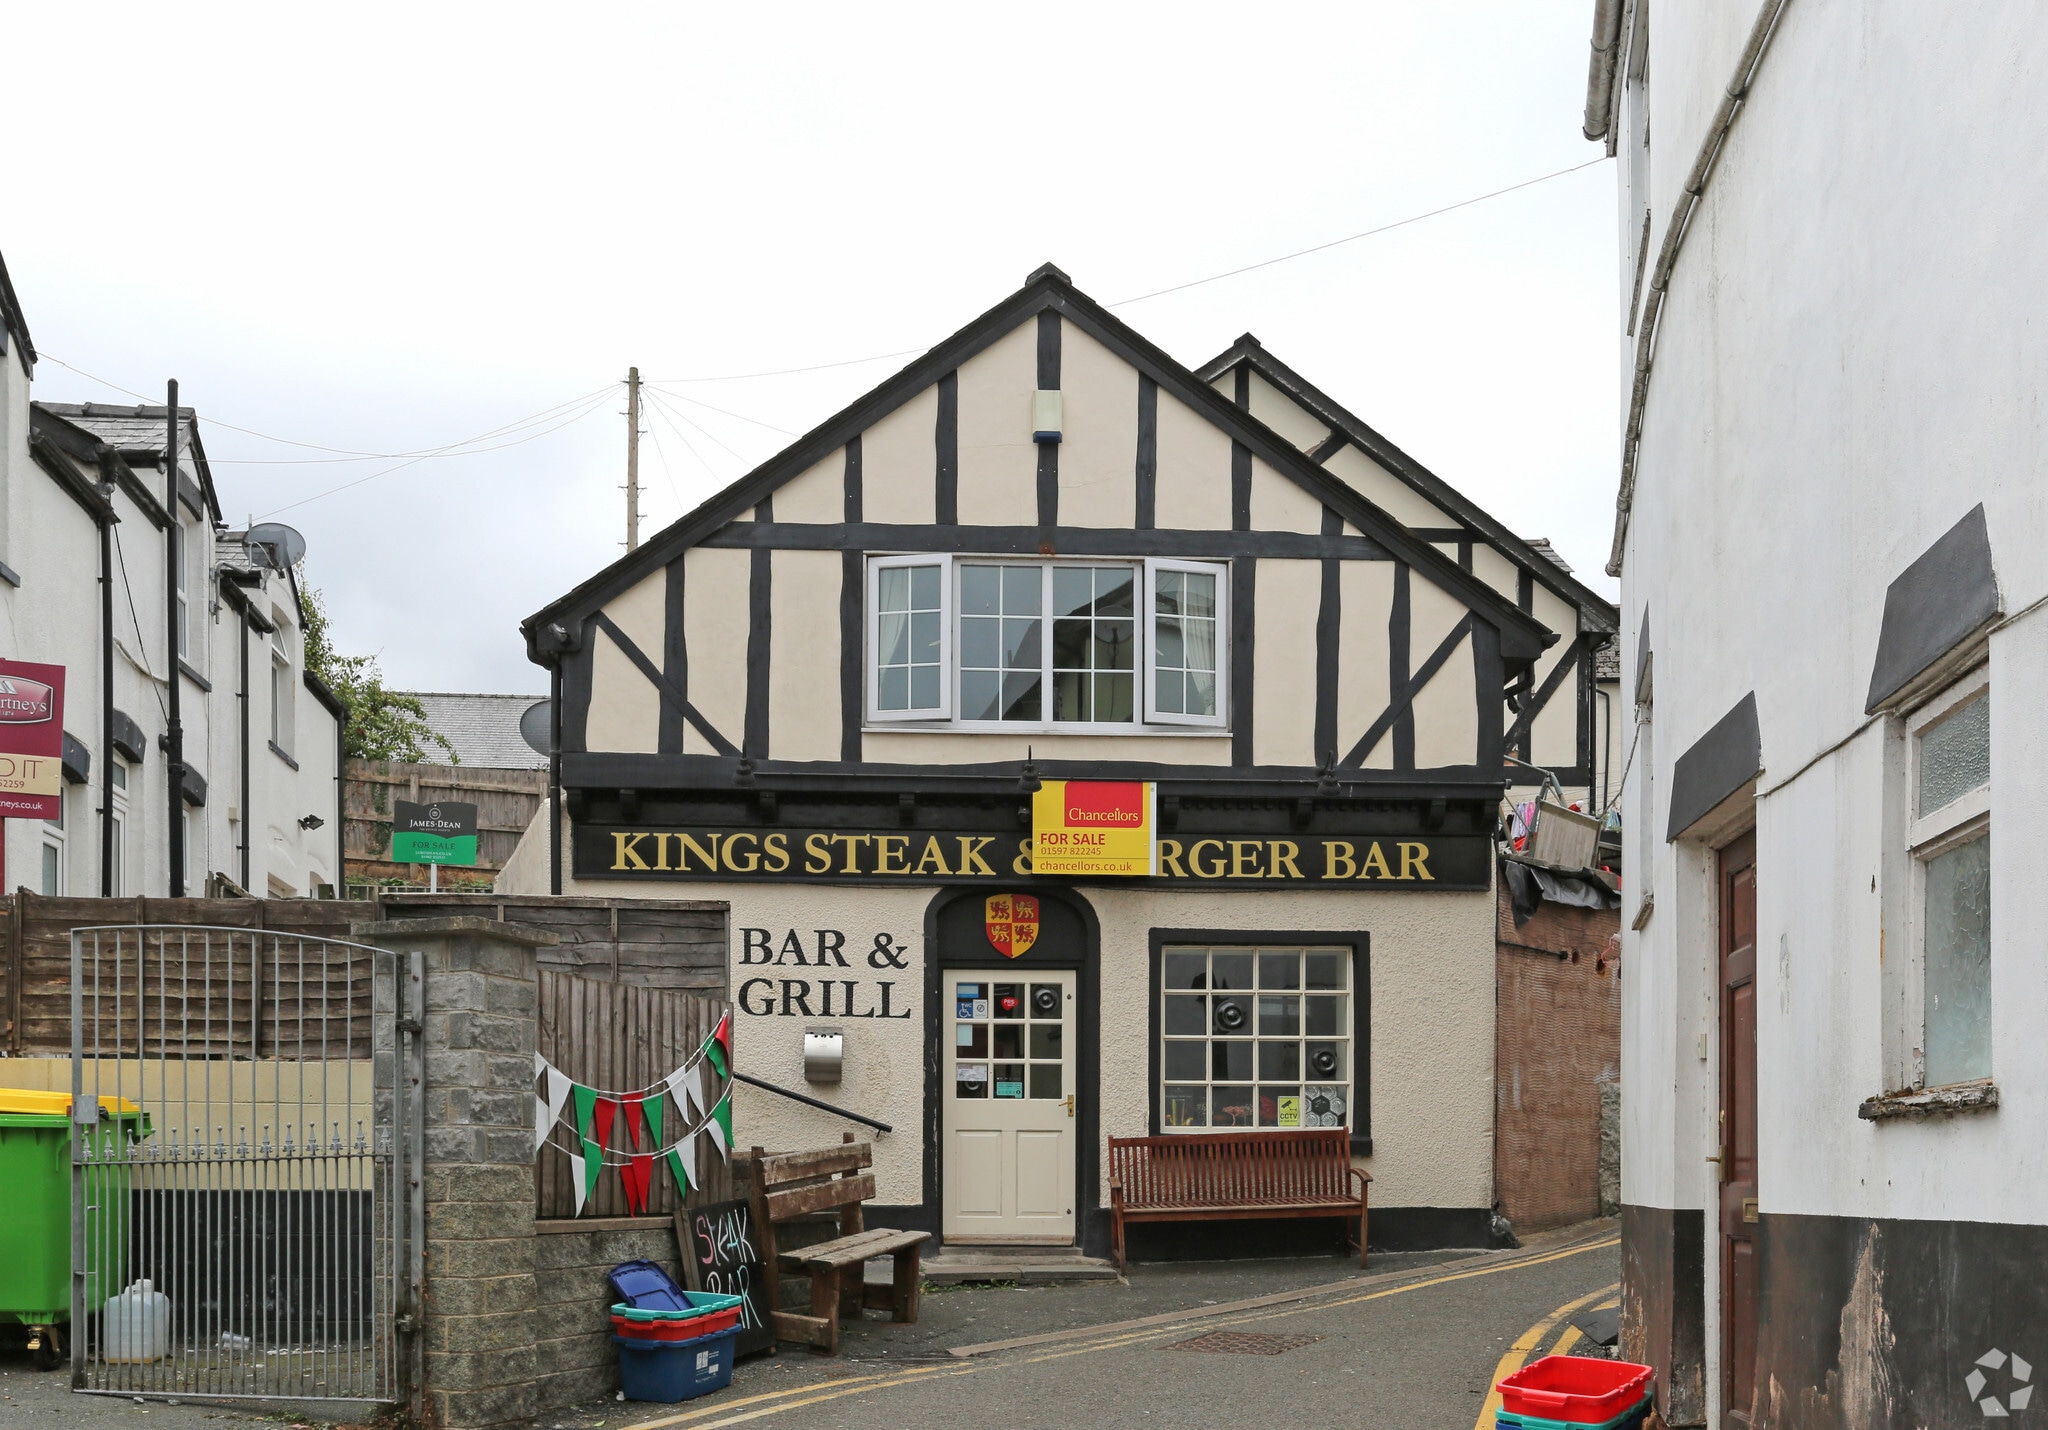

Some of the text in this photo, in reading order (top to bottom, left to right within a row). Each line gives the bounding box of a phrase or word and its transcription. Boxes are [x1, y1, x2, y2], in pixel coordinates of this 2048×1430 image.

[23, 759, 43, 779] IT
[1068, 807, 1139, 821] Chancellors
[412, 841, 456, 850] FOR SALE
[1040, 833, 1106, 846] FOR SALE
[610, 832, 790, 873] KINGS
[805, 833, 997, 876] STEAK
[1321, 841, 1436, 881] BAR
[1040, 847, 1102, 856] 01597 822245
[1040, 860, 1132, 872] chancellors.co.uk
[738, 928, 909, 970] BAR &
[738, 977, 911, 1019] GRILL
